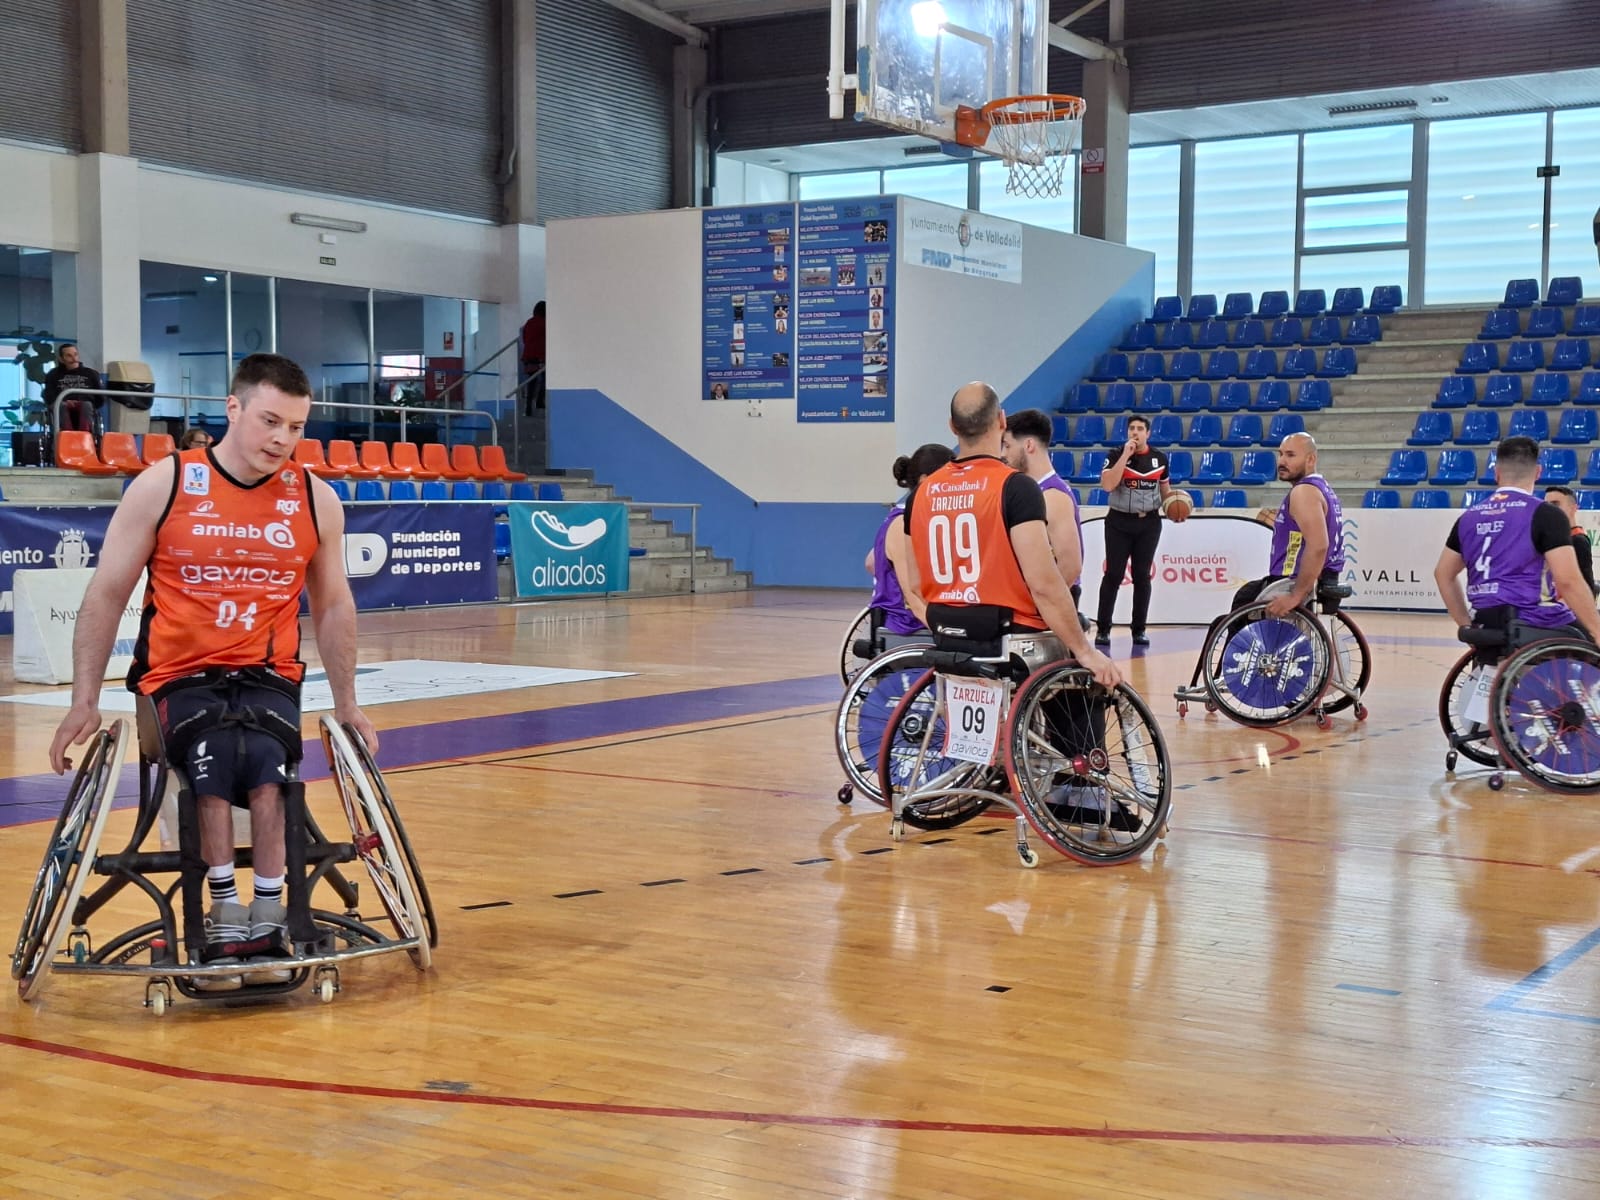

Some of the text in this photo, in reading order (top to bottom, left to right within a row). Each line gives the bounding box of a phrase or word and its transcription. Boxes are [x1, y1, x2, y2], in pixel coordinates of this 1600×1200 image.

[974, 229, 984, 241] de
[986, 230, 1021, 249] Valladolid
[931, 494, 975, 512] ZARZUELA
[192, 522, 262, 539] amiab
[391, 530, 461, 544] Fundación
[391, 545, 461, 559] Municipal
[928, 512, 982, 585] 09
[1162, 554, 1227, 565] Fundación
[1475, 536, 1492, 580] 4
[180, 564, 297, 585] gaviota
[391, 560, 482, 576] de Deportes
[532, 555, 606, 588] aliados
[1162, 567, 1229, 584] ONCE
[215, 600, 258, 631] 04
[953, 686, 996, 705] ZARZUELA
[962, 704, 986, 735] 09
[950, 742, 989, 758] gaviota
